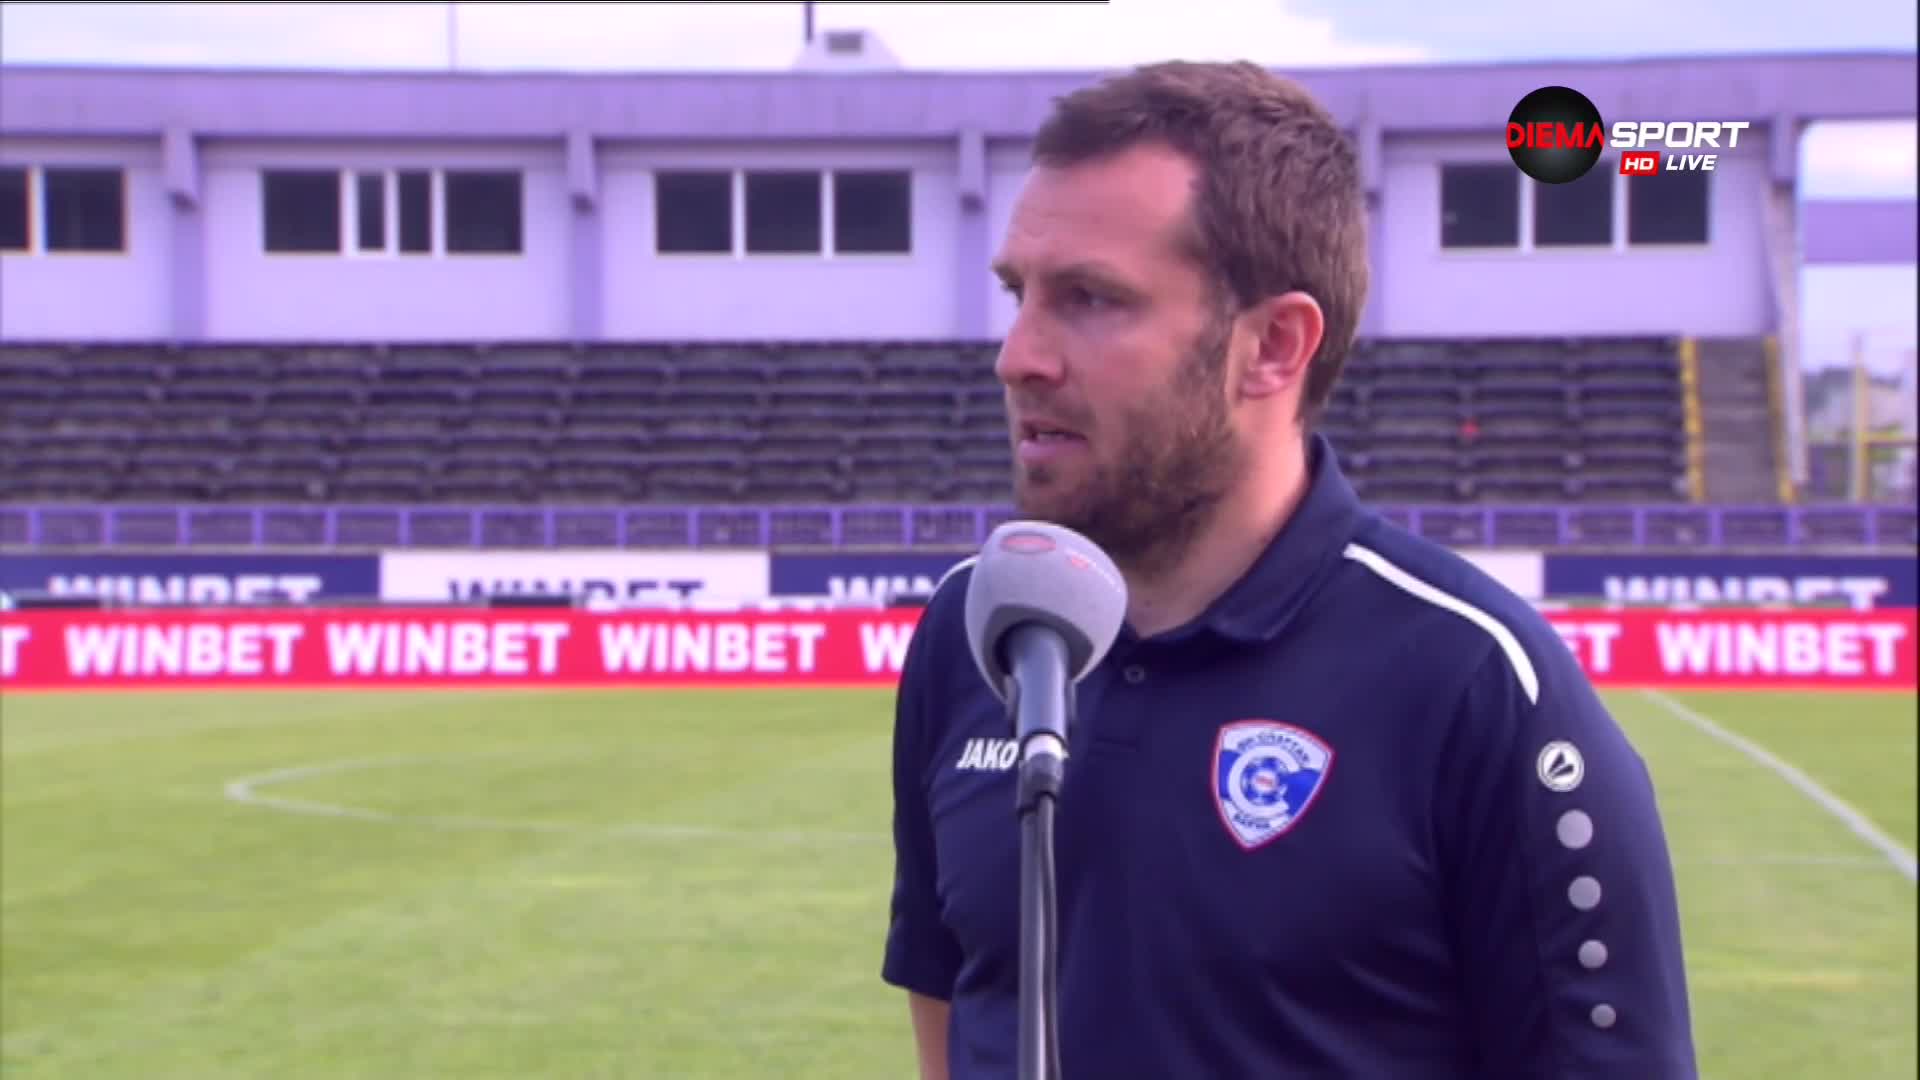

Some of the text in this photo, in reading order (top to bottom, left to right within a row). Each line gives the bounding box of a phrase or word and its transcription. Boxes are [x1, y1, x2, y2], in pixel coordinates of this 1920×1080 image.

[64, 623, 304, 675] WINBET
[326, 622, 570, 674] WINBET
[599, 623, 826, 672] WINBET
[1656, 623, 1906, 675] WINBET
[955, 737, 1020, 770] JAKO
